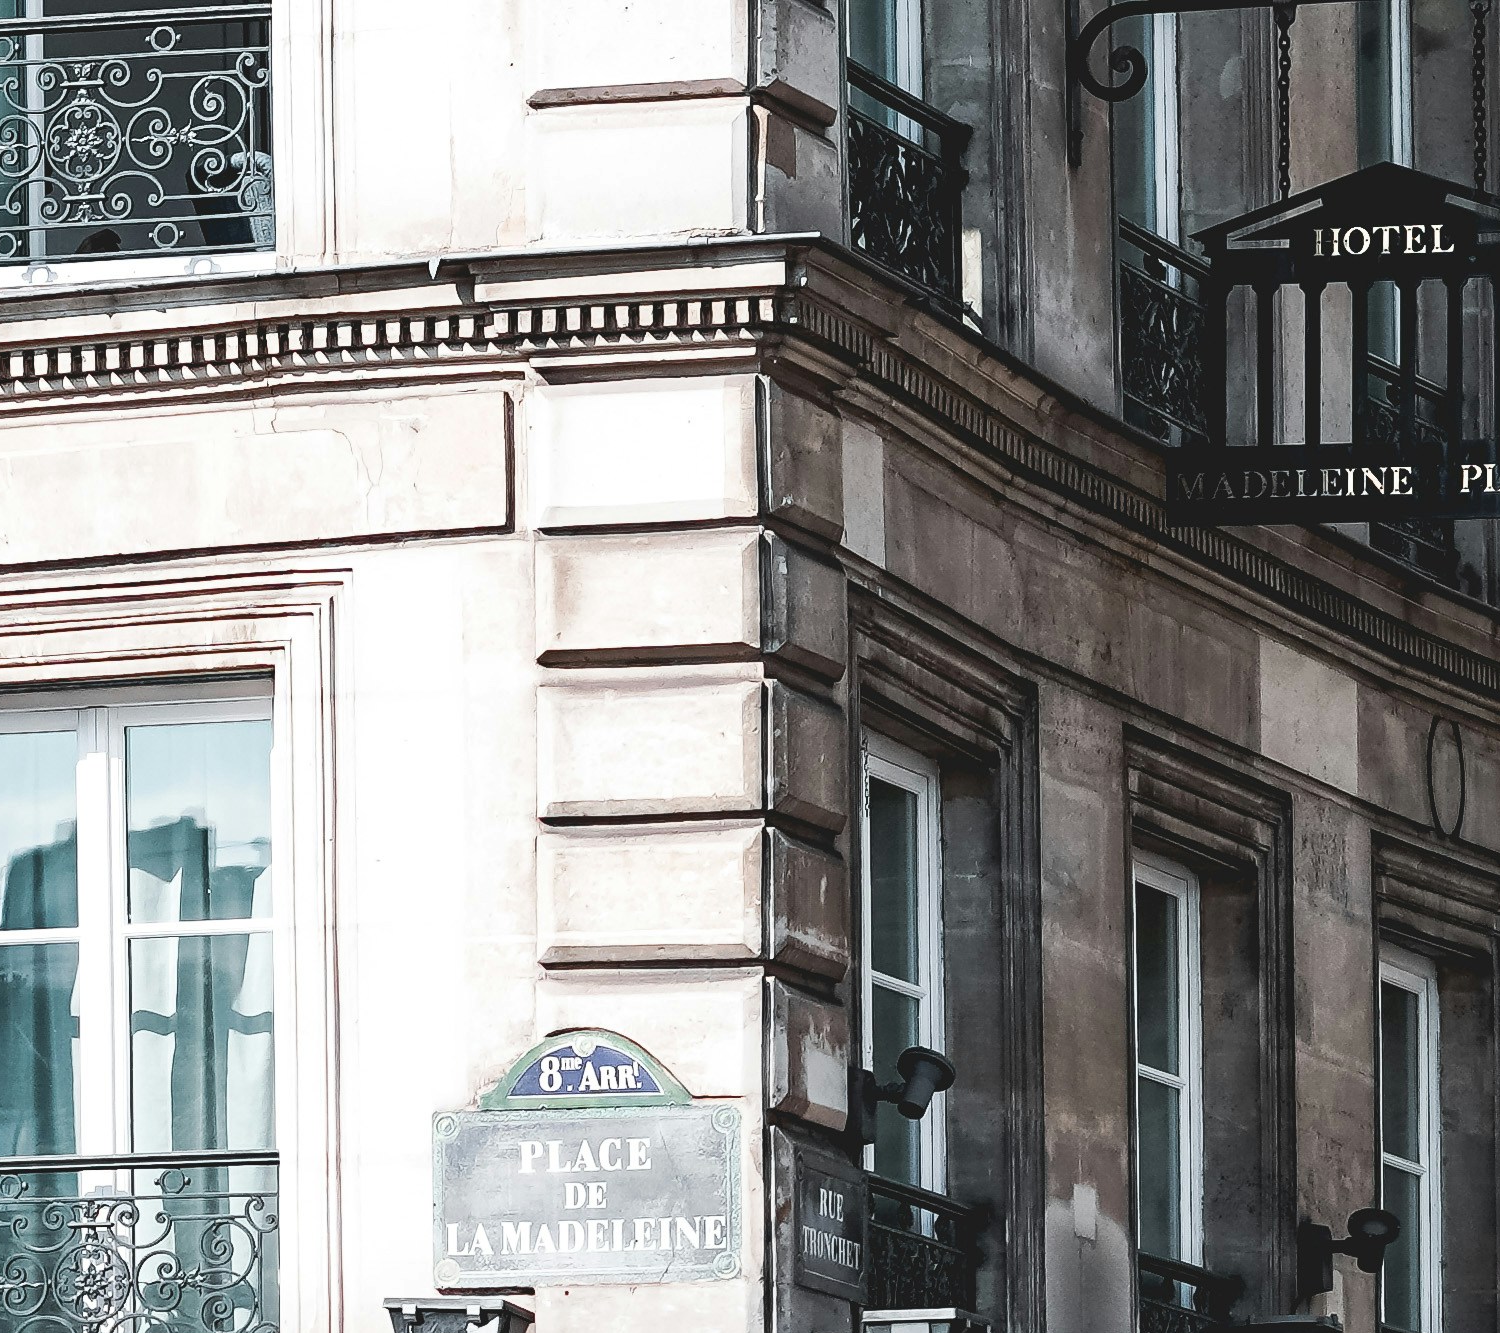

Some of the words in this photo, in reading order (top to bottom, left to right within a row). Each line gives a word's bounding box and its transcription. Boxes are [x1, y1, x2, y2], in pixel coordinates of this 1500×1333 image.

[1313, 224, 1455, 257] HOTEL
[1177, 466, 1413, 500] MADELEINE
[517, 1137, 652, 1174] PLACE
[563, 1181, 608, 1210] DE
[819, 1187, 845, 1221] RUE
[446, 1221, 495, 1256] LA
[499, 1215, 729, 1256] MADELEINE
[802, 1223, 862, 1272] TRONCHET
